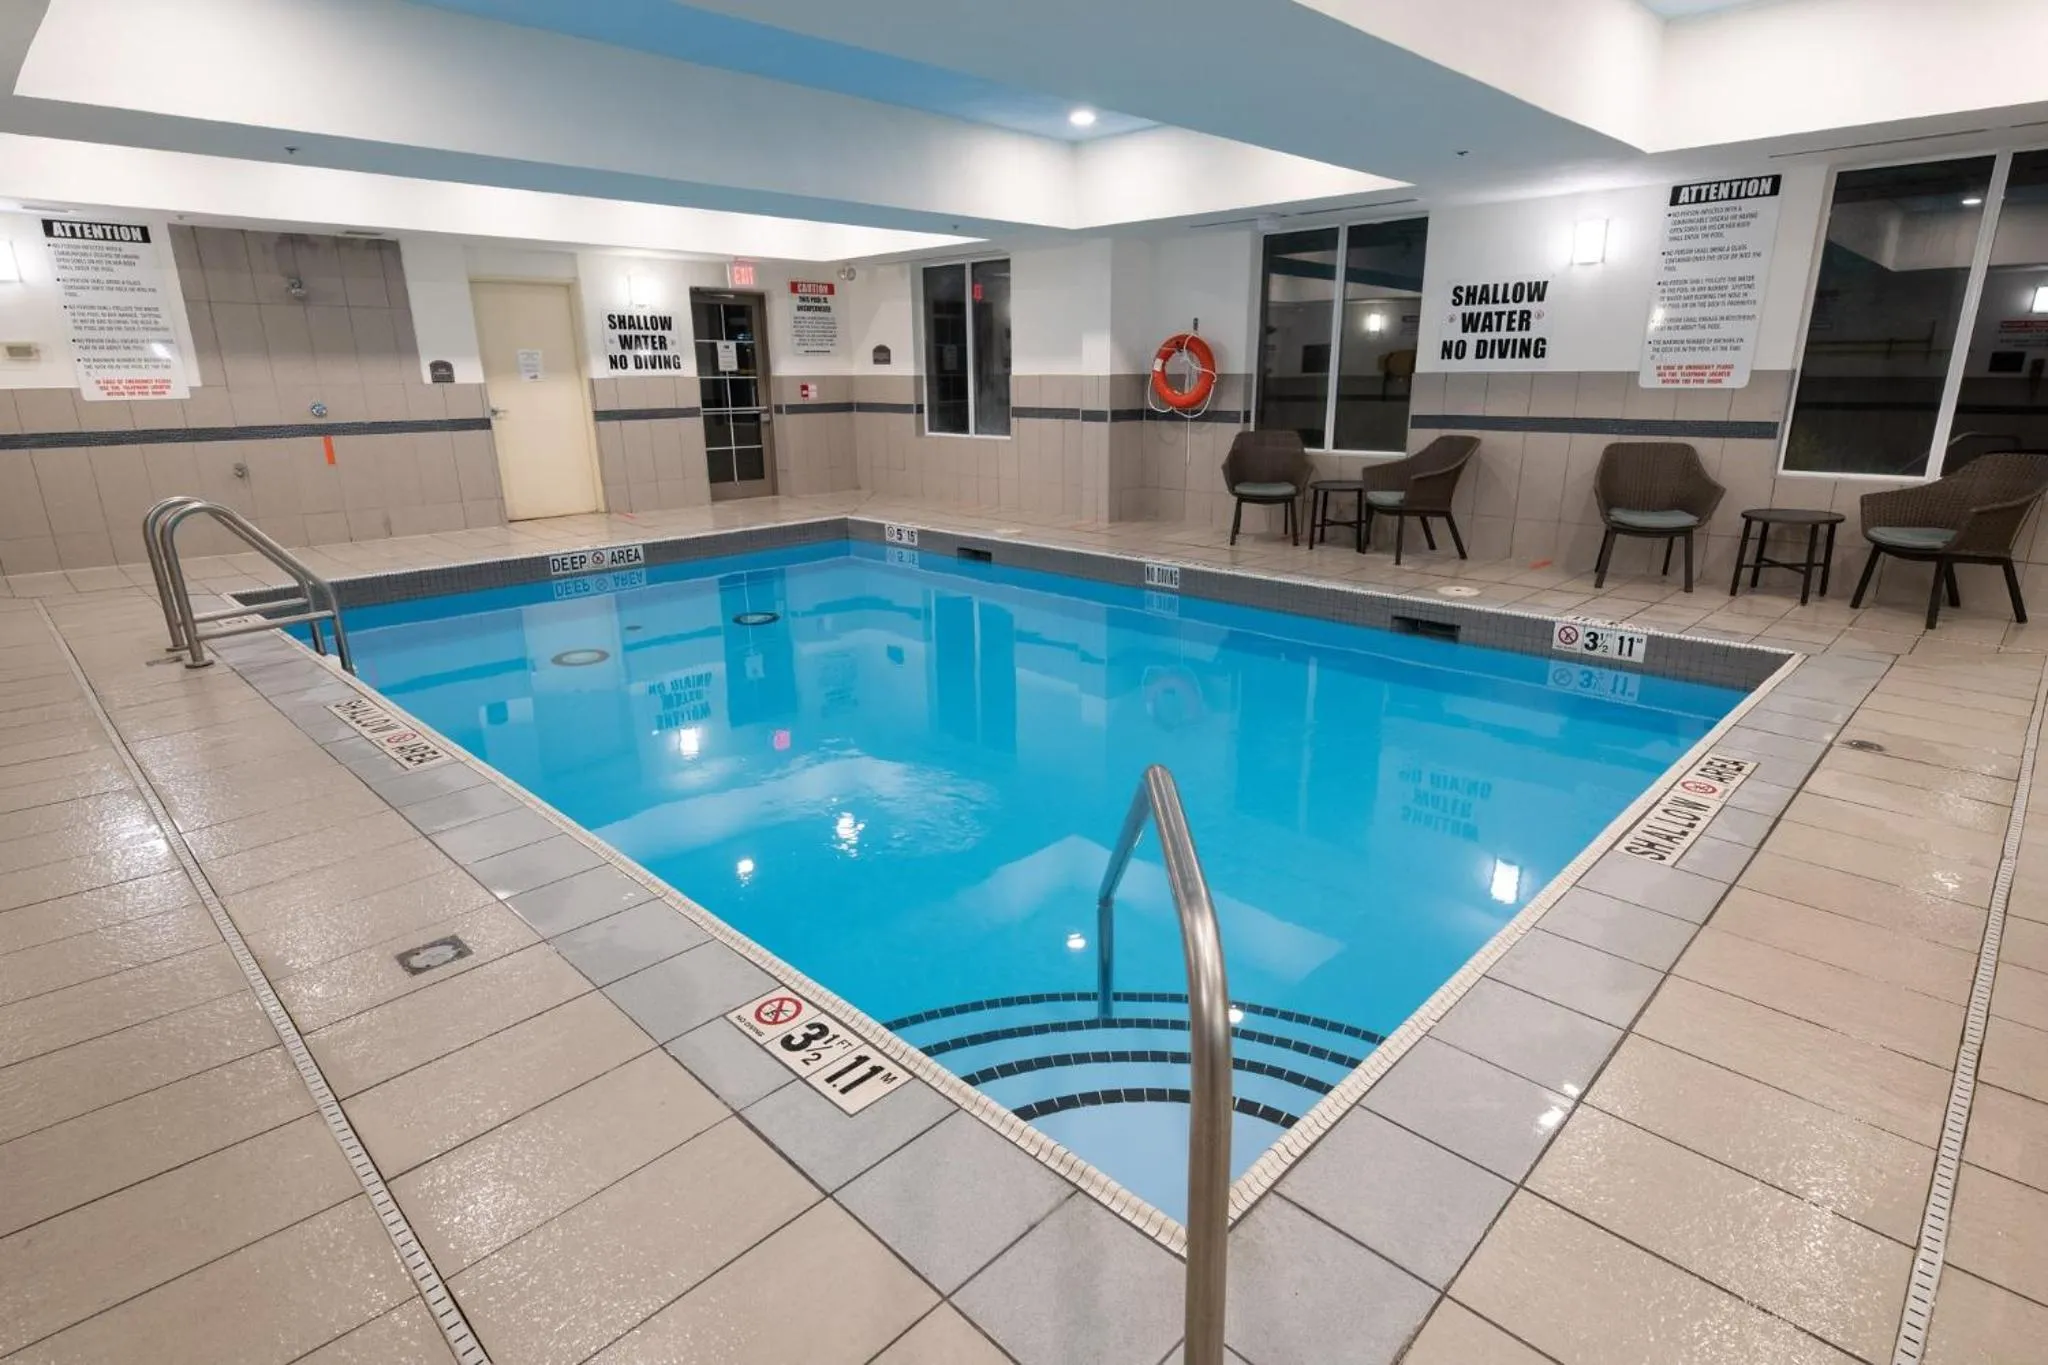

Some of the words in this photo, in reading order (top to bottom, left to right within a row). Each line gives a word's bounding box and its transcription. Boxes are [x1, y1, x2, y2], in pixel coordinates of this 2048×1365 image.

[1678, 178, 1772, 204] ATTENTION
[52, 221, 143, 242] ATTENTION
[1452, 280, 1548, 306] SHALLOW
[607, 314, 672, 331] SHALLOW
[1462, 310, 1532, 333] WATER
[618, 334, 668, 350] WATER
[1440, 340, 1467, 360] NO
[1475, 337, 1547, 360] DIVING
[608, 354, 628, 370] NO
[633, 354, 682, 370] DIVING
[551, 554, 586, 572] DEEP
[610, 548, 641, 564] AREA
[334, 700, 400, 733] SHALLOW
[392, 742, 443, 766] AREA
[1624, 796, 1710, 861] SHALLOW
[1696, 756, 1748, 784] AREA
[837, 1034, 853, 1049] FT
[879, 1072, 898, 1084] M
